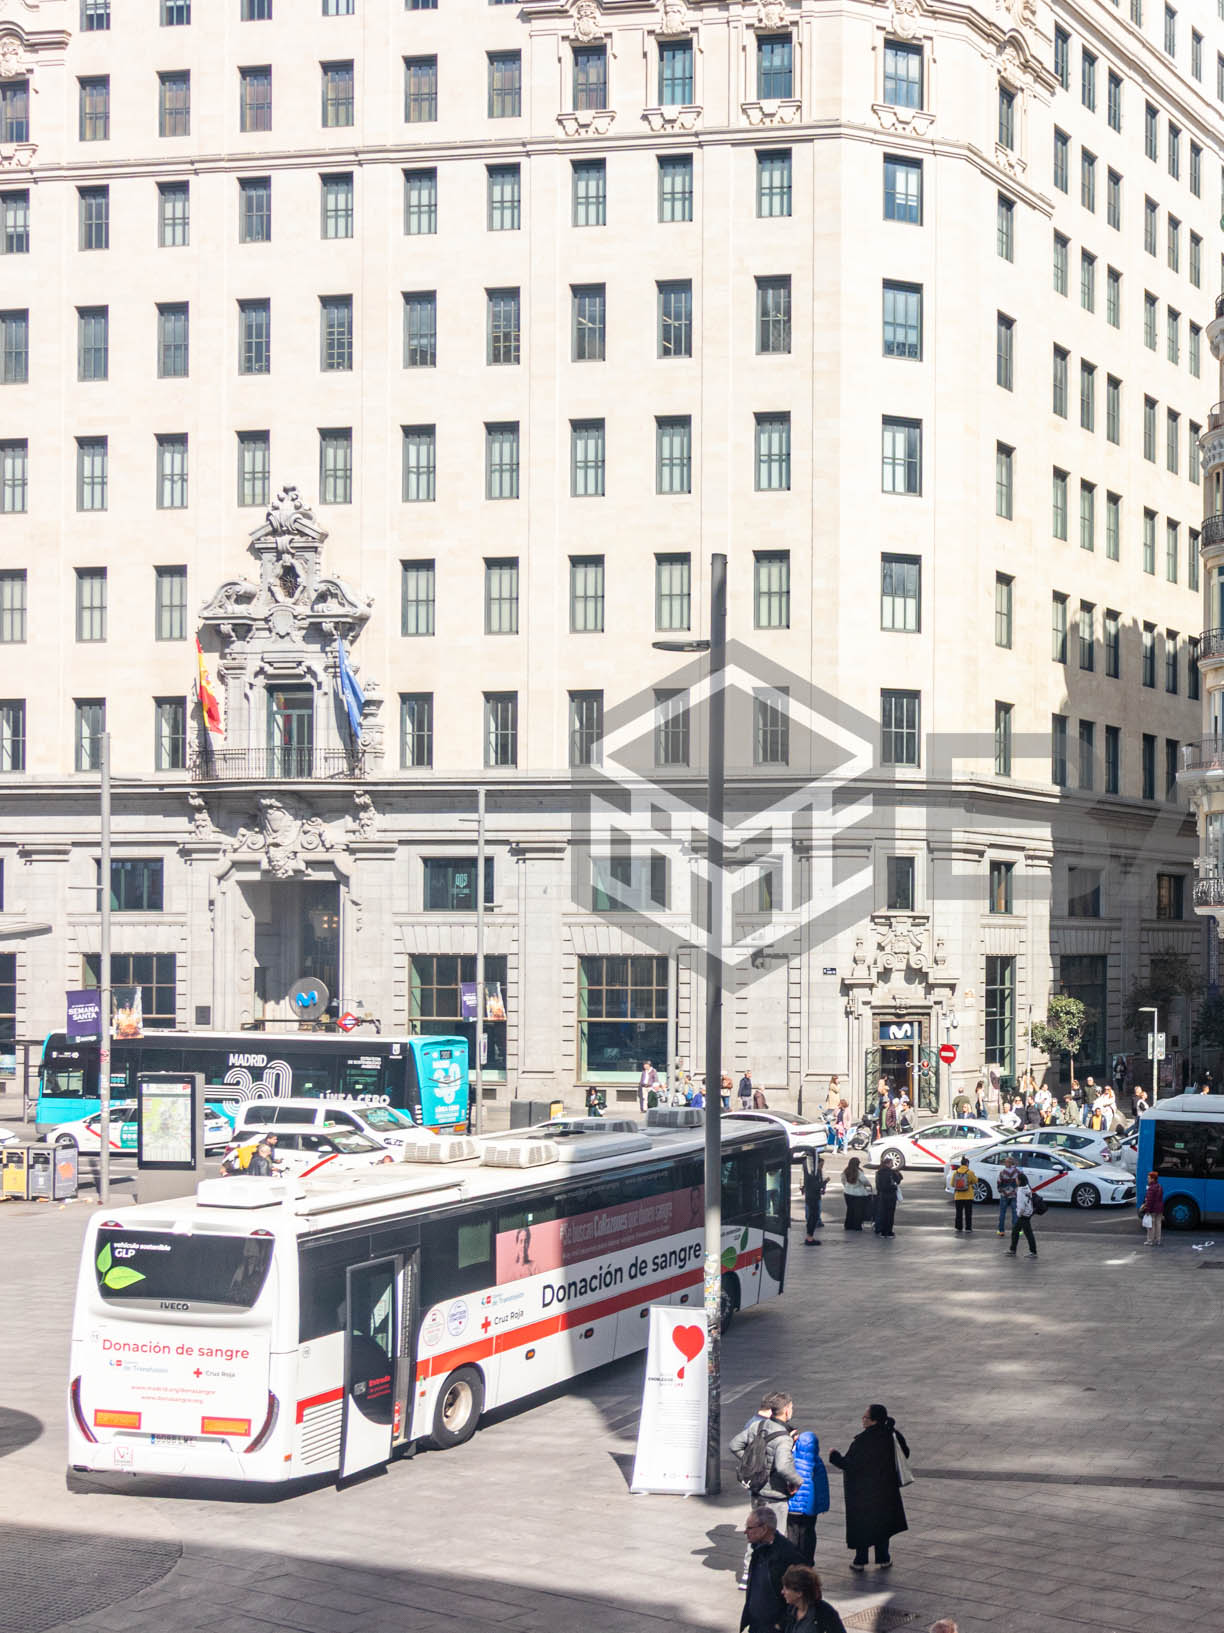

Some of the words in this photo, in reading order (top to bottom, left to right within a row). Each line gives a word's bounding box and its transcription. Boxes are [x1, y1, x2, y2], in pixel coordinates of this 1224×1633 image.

[68, 1006, 100, 1015] SEMANA
[72, 1012, 97, 1021] SANTA
[229, 1053, 267, 1067] MADRID
[114, 1249, 136, 1258] GLP
[541, 1263, 624, 1308] Donación
[628, 1255, 648, 1280] de
[651, 1240, 702, 1273] sangre
[160, 1301, 189, 1311] IVECO
[494, 1314, 509, 1325] Cruz
[510, 1308, 524, 1320] Roja
[102, 1339, 171, 1355] Donación
[176, 1344, 194, 1356] de
[198, 1348, 250, 1361] sangre
